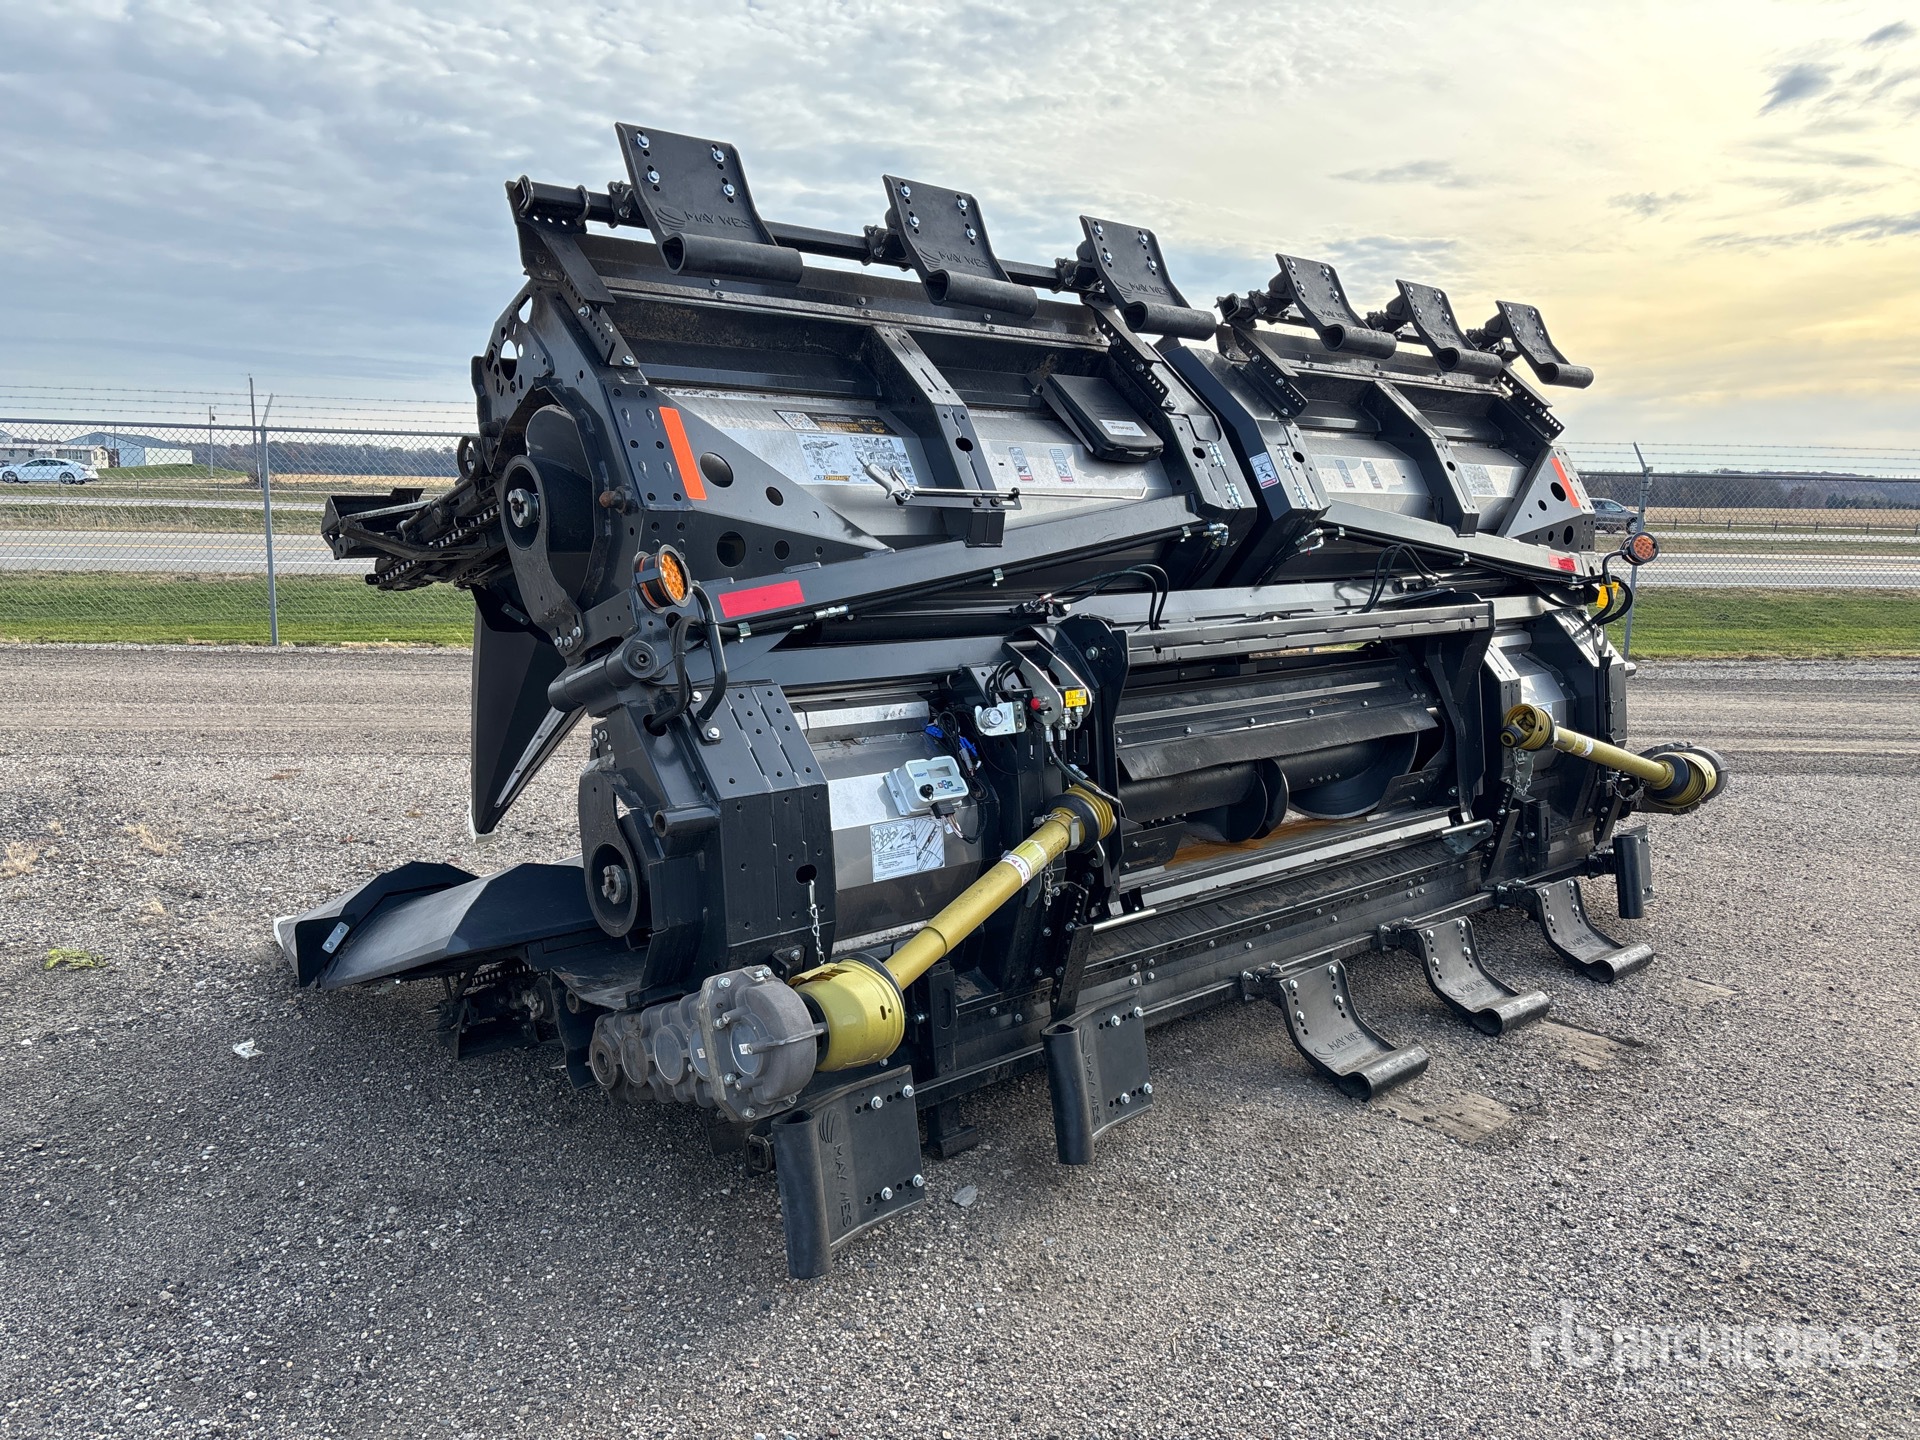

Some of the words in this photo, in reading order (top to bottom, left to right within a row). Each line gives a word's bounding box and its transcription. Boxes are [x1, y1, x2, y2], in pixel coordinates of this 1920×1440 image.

[684, 210, 715, 224] MAY
[717, 214, 753, 230] WES
[938, 251, 962, 264] MAY
[963, 255, 990, 269] WES
[1128, 282, 1149, 292] MAY
[1326, 1036, 1347, 1051] MAY
[1343, 1029, 1366, 1043] WES
[1085, 1053, 1096, 1086] MAY
[833, 1142, 848, 1181] MAY
